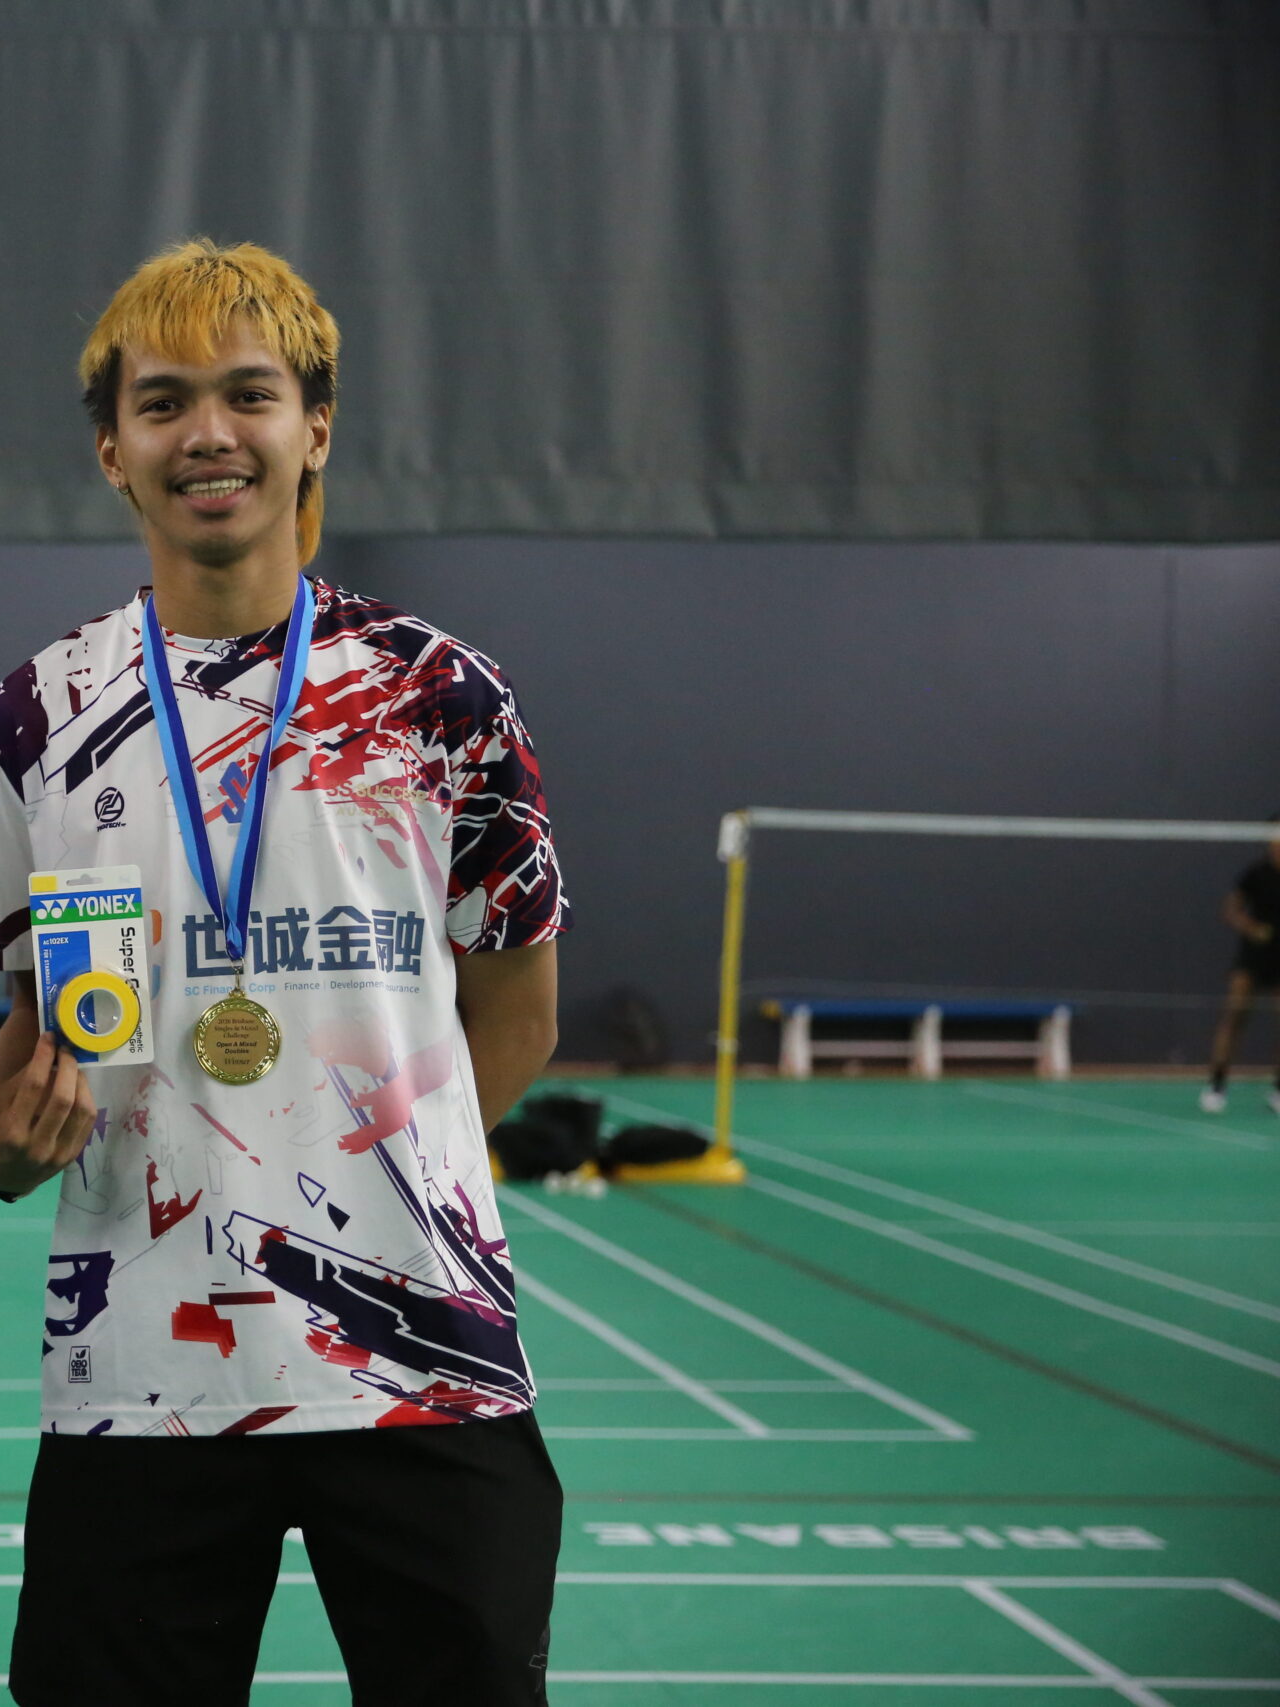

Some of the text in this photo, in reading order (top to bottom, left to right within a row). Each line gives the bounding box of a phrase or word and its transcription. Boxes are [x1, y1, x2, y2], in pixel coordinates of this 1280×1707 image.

[73, 893, 136, 917] YONEX
[119, 926, 135, 973] Super
[182, 906, 425, 978] 世诚金融
[184, 986, 200, 996] SC
[248, 982, 276, 994] Corp
[284, 981, 320, 992] Finance
[330, 980, 384, 990] Developmen
[128, 1038, 136, 1053] Grip
[582, 1521, 1166, 1550] BRISBANE
